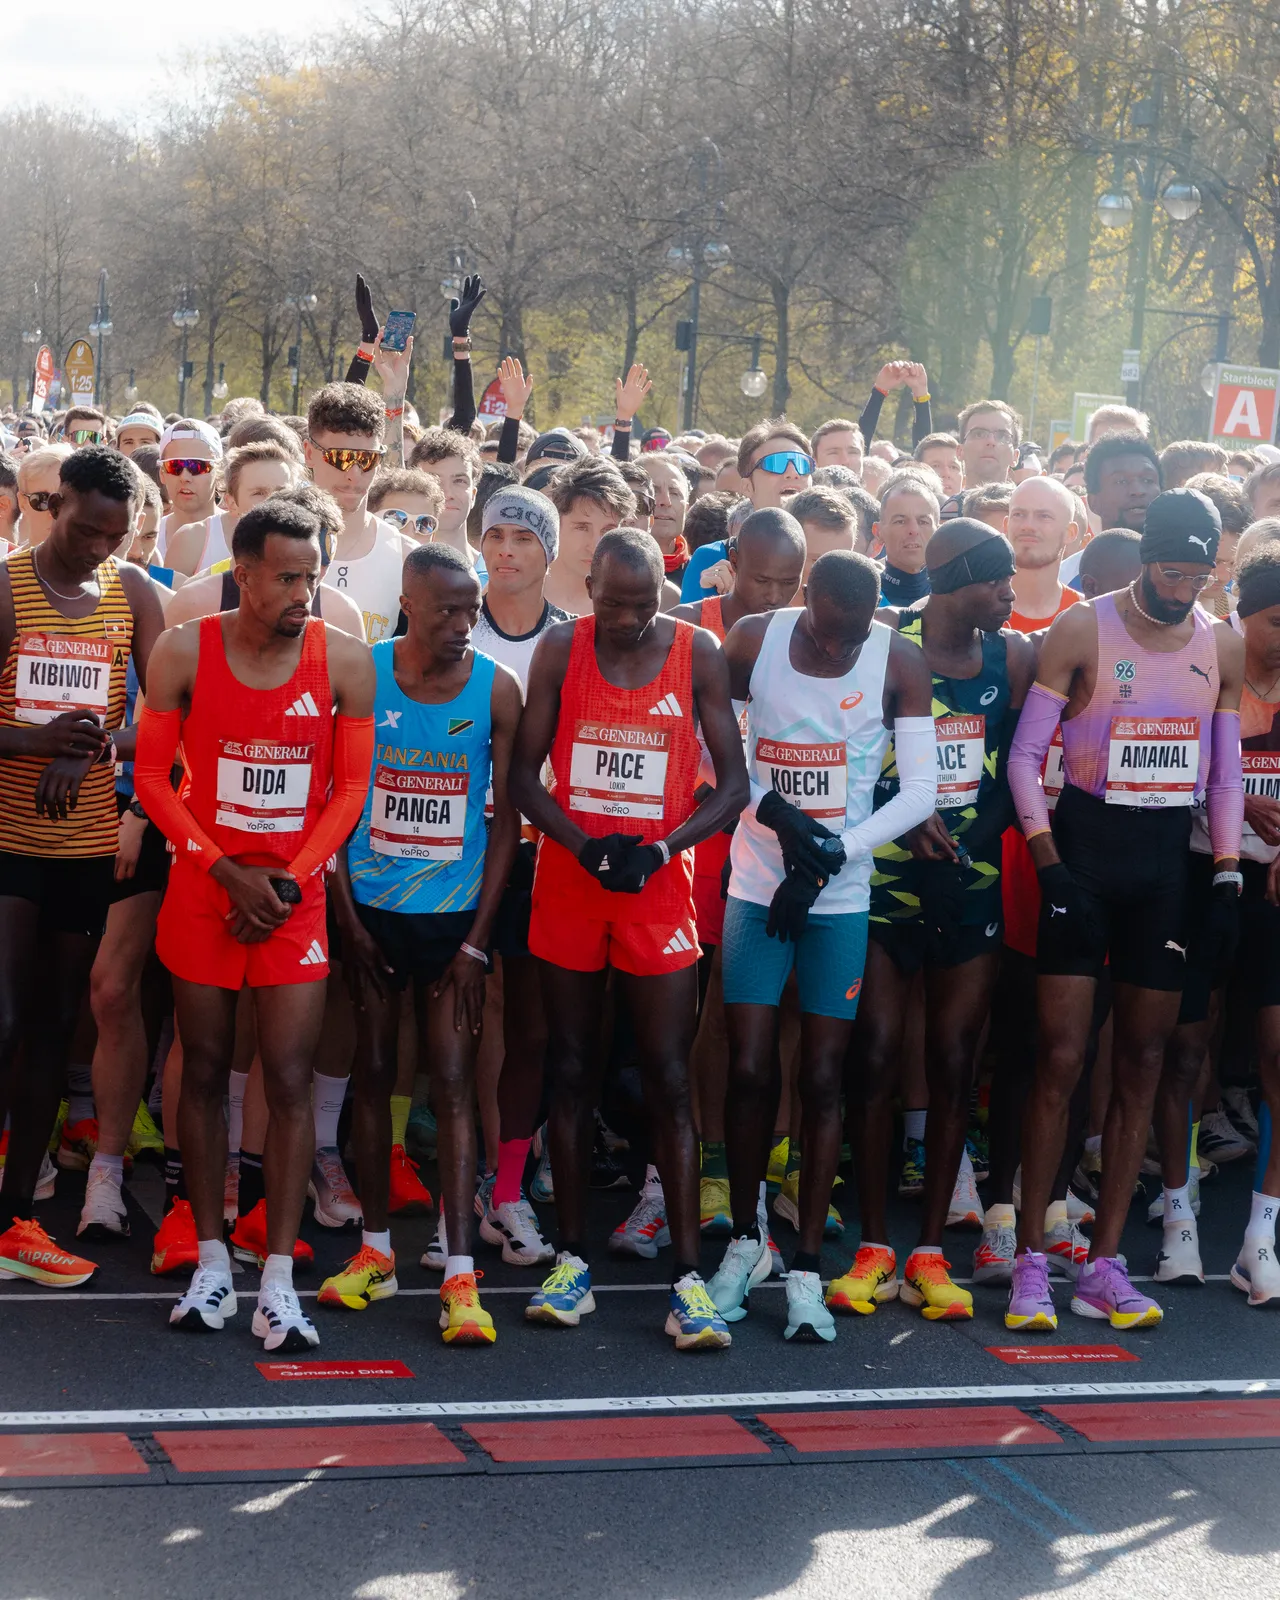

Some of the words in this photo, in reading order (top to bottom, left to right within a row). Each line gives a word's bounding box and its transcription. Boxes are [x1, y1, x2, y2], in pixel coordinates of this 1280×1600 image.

[71, 375, 93, 391] 1:25
[1222, 372, 1275, 387] Startblock
[1222, 390, 1262, 437] A
[46, 640, 109, 657] GENERALI
[29, 661, 102, 690] KIBIWOT
[1113, 660, 1136, 681] 96
[61, 692, 70, 701] 60
[936, 720, 981, 736] NERALI
[1137, 722, 1195, 736] GENERALI
[599, 728, 665, 747] GENERALI
[244, 744, 309, 760] GENERALI
[377, 743, 468, 770] TANZANIA
[776, 747, 841, 762] GENERALI
[936, 743, 967, 771] ACE
[1120, 745, 1189, 769] AMANAL
[596, 750, 646, 780] PACE
[1251, 756, 1280, 769] GEN
[243, 767, 286, 795] DIDA
[396, 775, 464, 791] GENERALI
[770, 767, 829, 796] KOECH
[261, 799, 266, 807] 2
[1140, 796, 1167, 805] YoPRO
[384, 794, 451, 825] PANGA
[602, 805, 630, 815] YoPRO
[246, 821, 276, 831] YoPRO
[413, 826, 420, 834] 14
[400, 848, 430, 858] YoPRO
[18, 1249, 75, 1266] KIPRUN
[0, 1414, 89, 1422] VENTS
